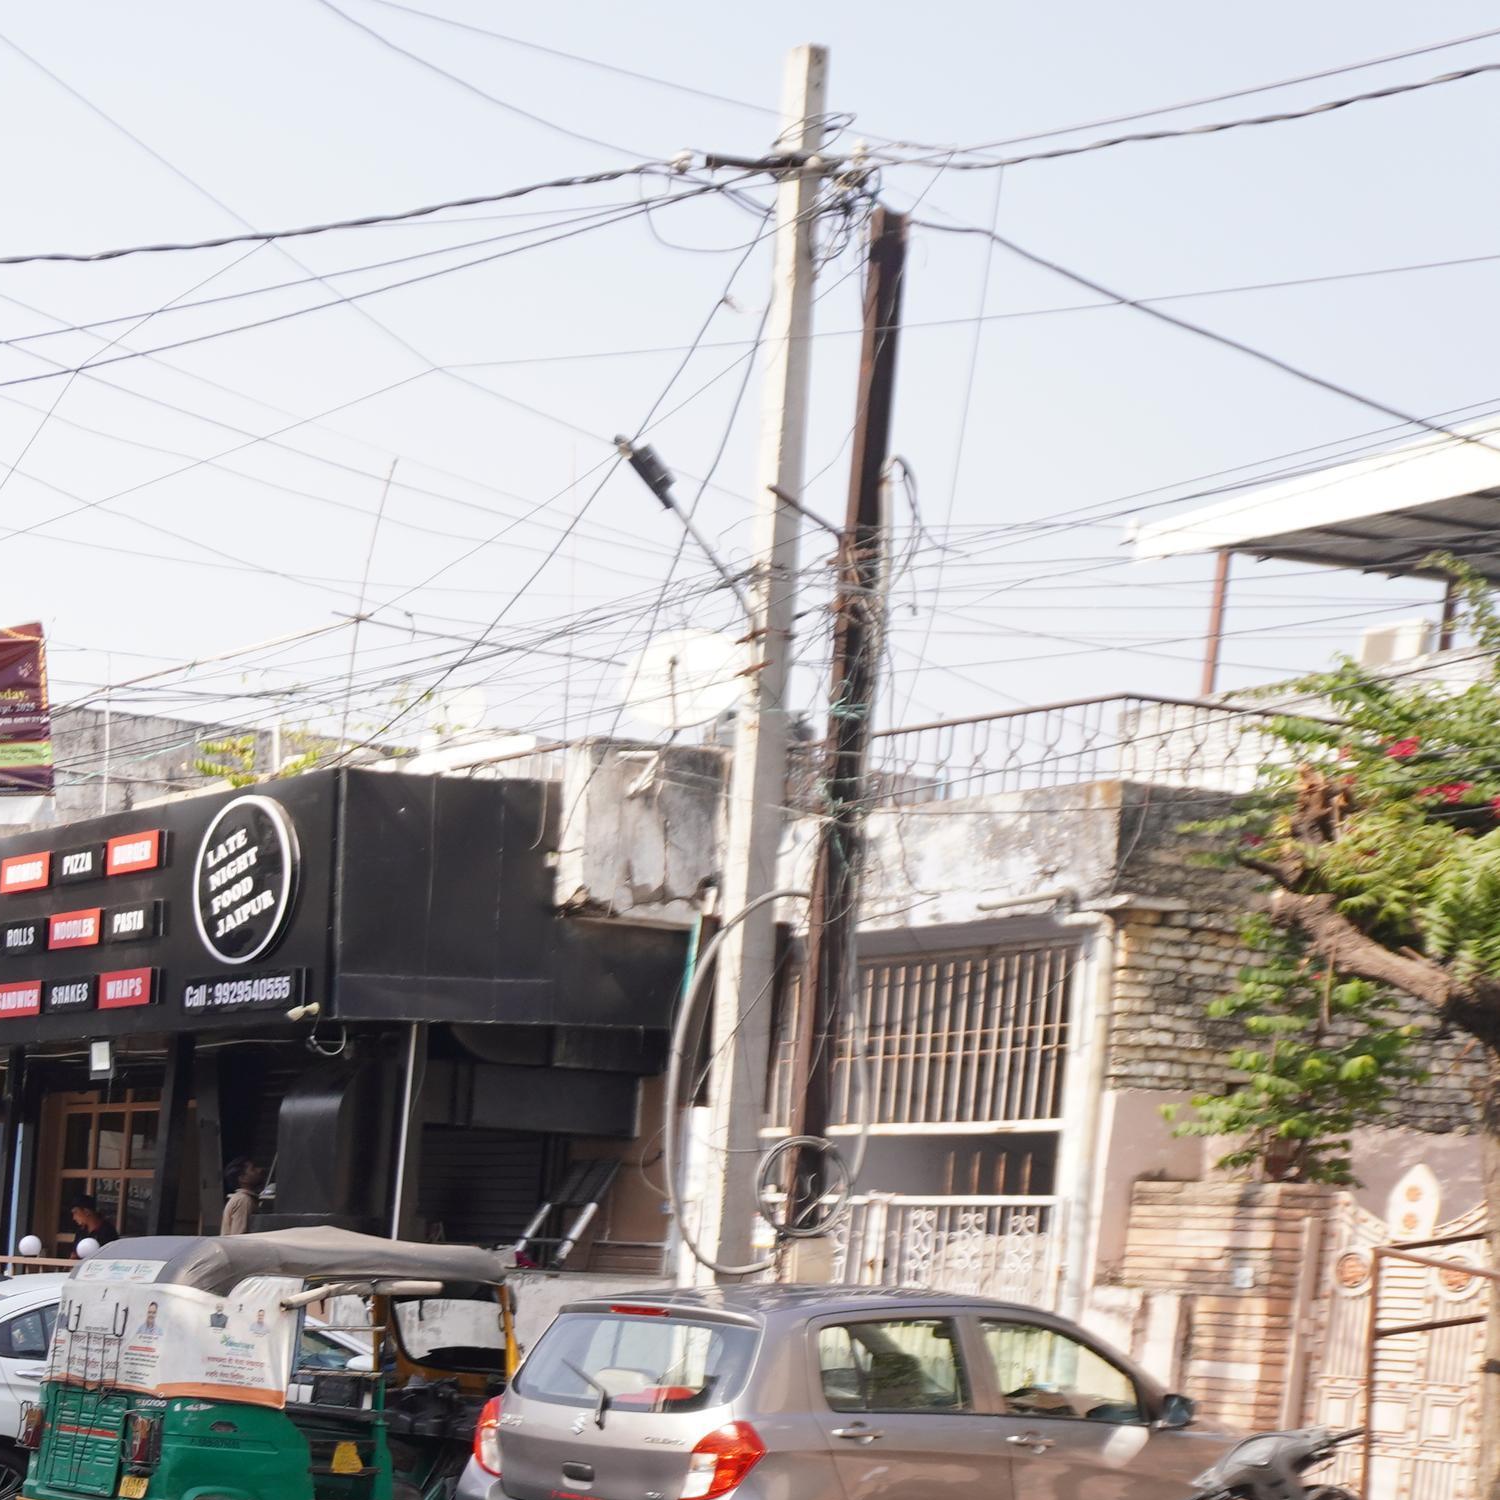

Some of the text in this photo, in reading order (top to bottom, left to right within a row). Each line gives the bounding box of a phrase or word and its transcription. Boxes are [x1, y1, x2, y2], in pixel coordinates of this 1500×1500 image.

[5, 860, 43, 885] MOMOS
[62, 850, 93, 876] PIZZA
[206, 827, 249, 869] LATE
[208, 845, 260, 892] NIGHT
[211, 875, 255, 916] FOOD
[215, 888, 276, 938] JAIPUR
[6, 909, 145, 949] ROLLS NOODLES PASTA
[51, 982, 89, 1005] SHAKES
[106, 976, 143, 1001] WRAPS
[214, 975, 292, 1004] 9929540555
